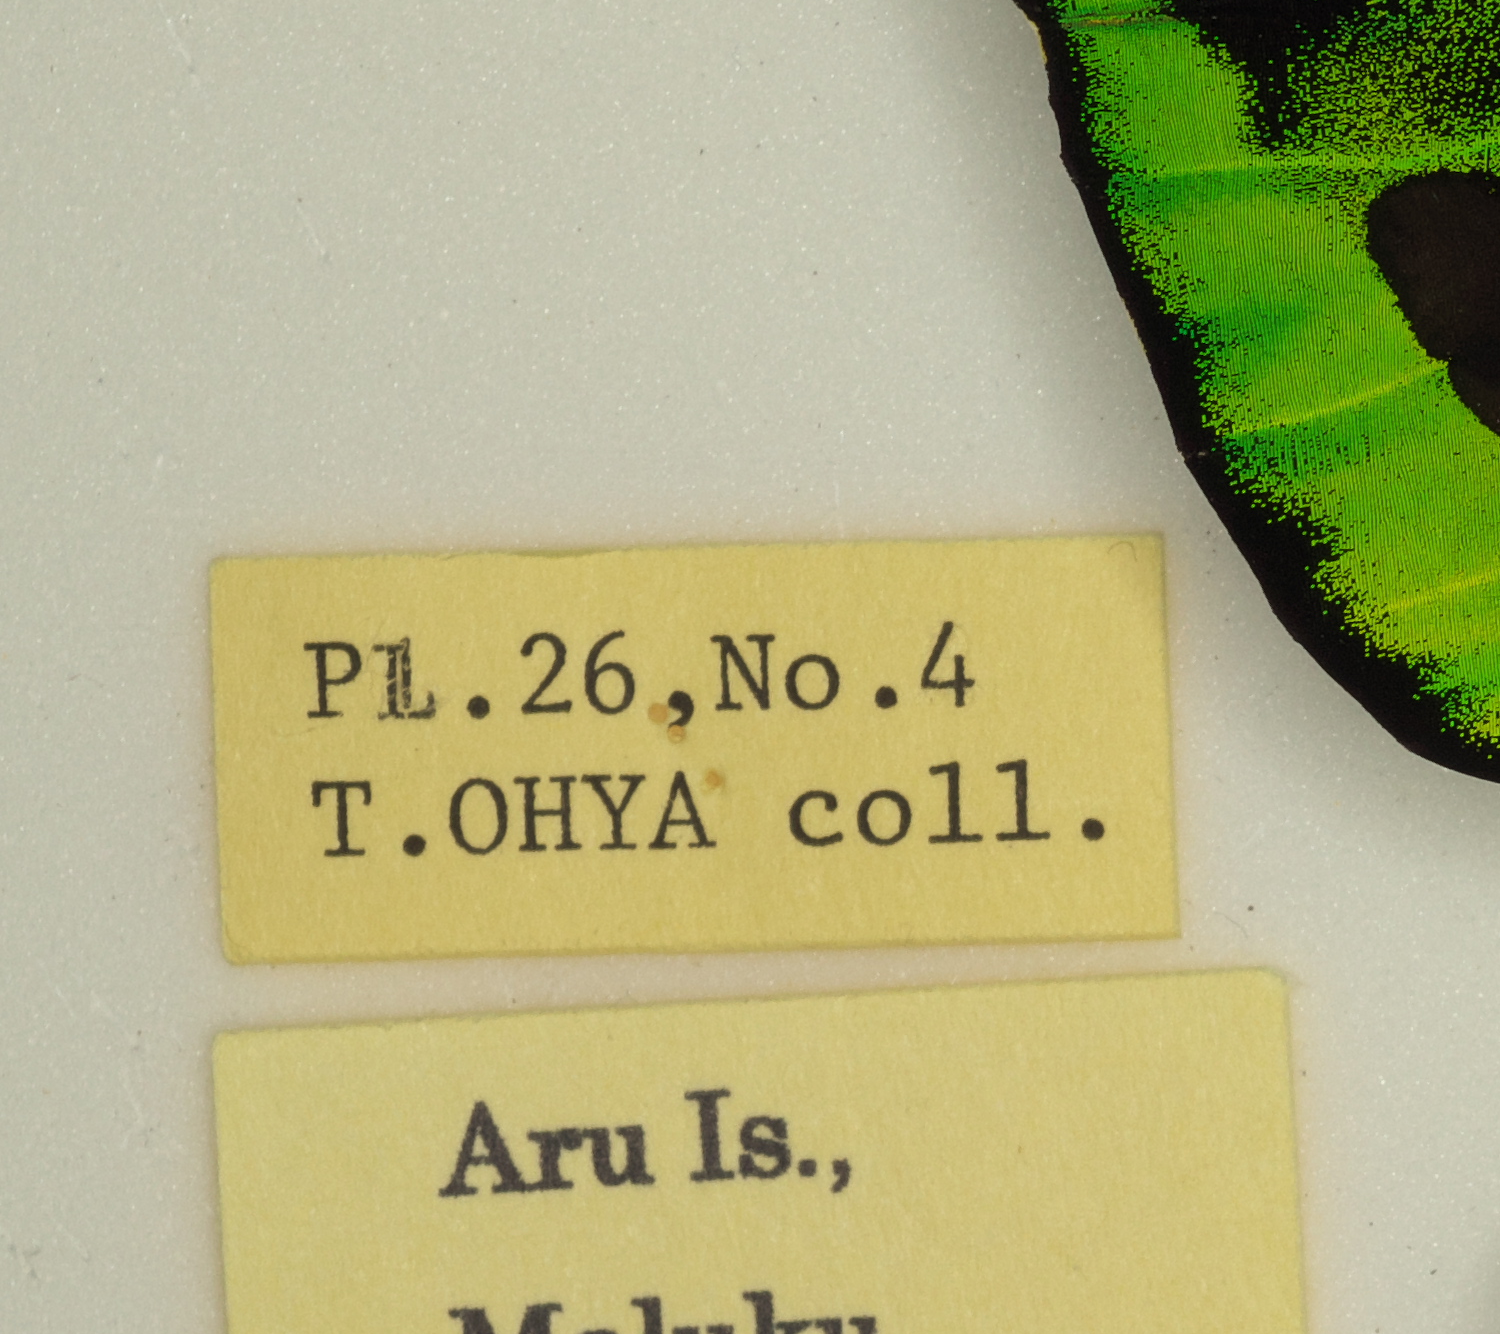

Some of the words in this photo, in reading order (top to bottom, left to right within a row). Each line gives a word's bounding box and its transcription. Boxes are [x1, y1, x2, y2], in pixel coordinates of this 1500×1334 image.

[311, 769, 718, 859] T.OHYA
[788, 757, 1106, 848] coll.
[438, 1100, 656, 1199] Aru
[684, 1087, 853, 1194] Is.,
